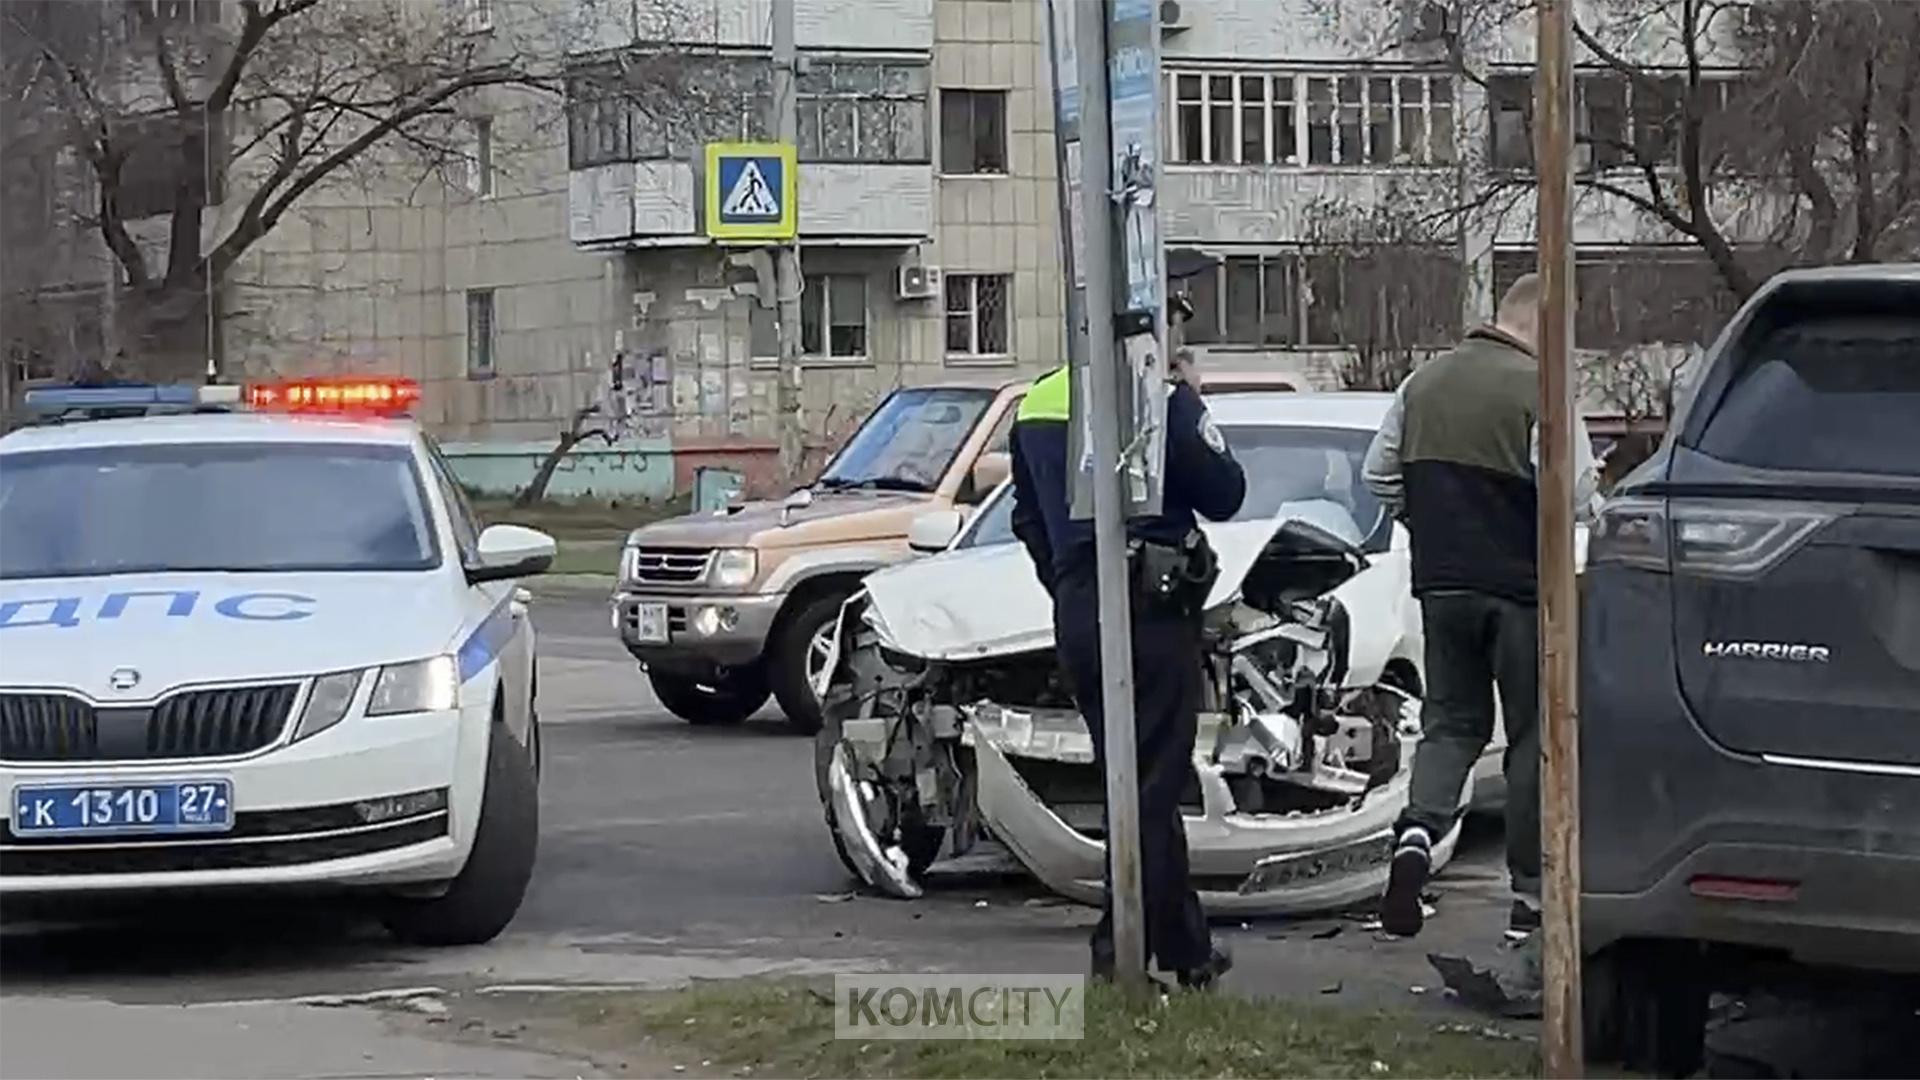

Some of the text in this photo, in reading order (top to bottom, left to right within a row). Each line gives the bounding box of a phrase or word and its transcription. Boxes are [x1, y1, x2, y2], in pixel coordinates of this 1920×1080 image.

[0, 591, 317, 628] ДПС
[1703, 642, 1830, 662] HARRIER
[34, 785, 216, 826] К 1310 27
